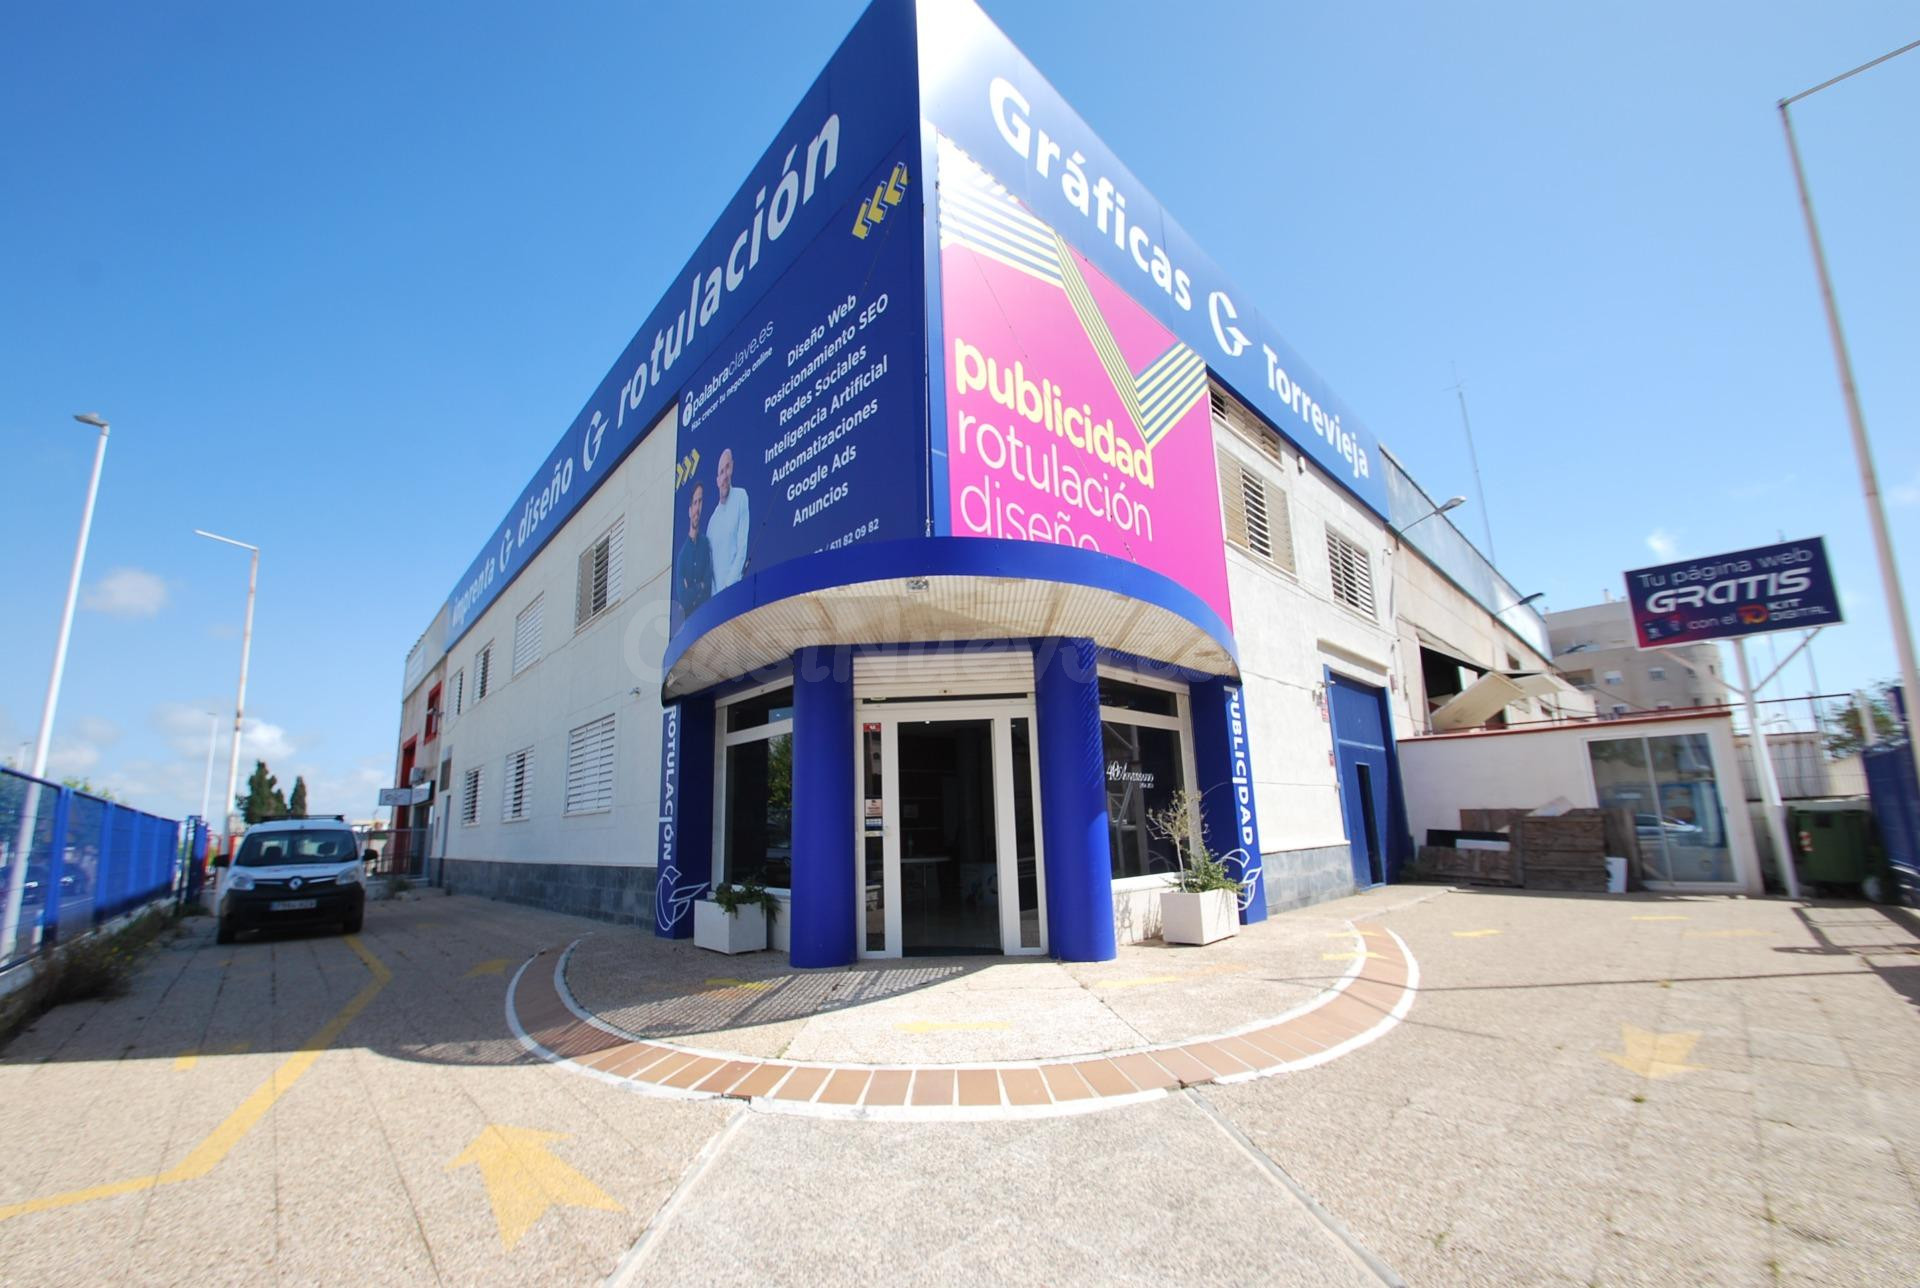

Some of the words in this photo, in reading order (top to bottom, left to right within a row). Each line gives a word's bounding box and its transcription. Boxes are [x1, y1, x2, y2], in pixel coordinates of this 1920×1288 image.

[988, 76, 1192, 312] Gráficas
[1262, 342, 1371, 481] Torrevieja
[517, 456, 574, 549] diseño
[616, 112, 841, 430] rotulación
[692, 320, 775, 419] palabraclave.es
[764, 325, 856, 414] Posicionamiento
[858, 293, 889, 330] SEO
[787, 324, 825, 368] Diseño
[827, 294, 857, 329] Web
[764, 407, 828, 465] Inteligencia
[830, 354, 888, 414] Artificial
[779, 390, 813, 427] Redes
[815, 345, 867, 397] Sociales
[953, 337, 1155, 490] publicidad
[770, 398, 879, 487] Automatizaciones
[786, 464, 829, 501] Google
[831, 444, 857, 473] Ads
[957, 410, 1154, 542] rotulación
[792, 481, 849, 528] Anuncios
[843, 532, 853, 547] 82
[854, 525, 867, 540] 09
[868, 518, 880, 533] 82
[1637, 571, 1666, 588] Tu
[1671, 559, 1752, 586] página
[1757, 547, 1814, 569] web
[1646, 567, 1812, 614] GRATIS
[1687, 615, 1719, 630] con
[1720, 612, 1738, 625] el
[659, 705, 677, 861] ROTULACIÓN
[1223, 685, 1254, 846] PUBLICIDAD
